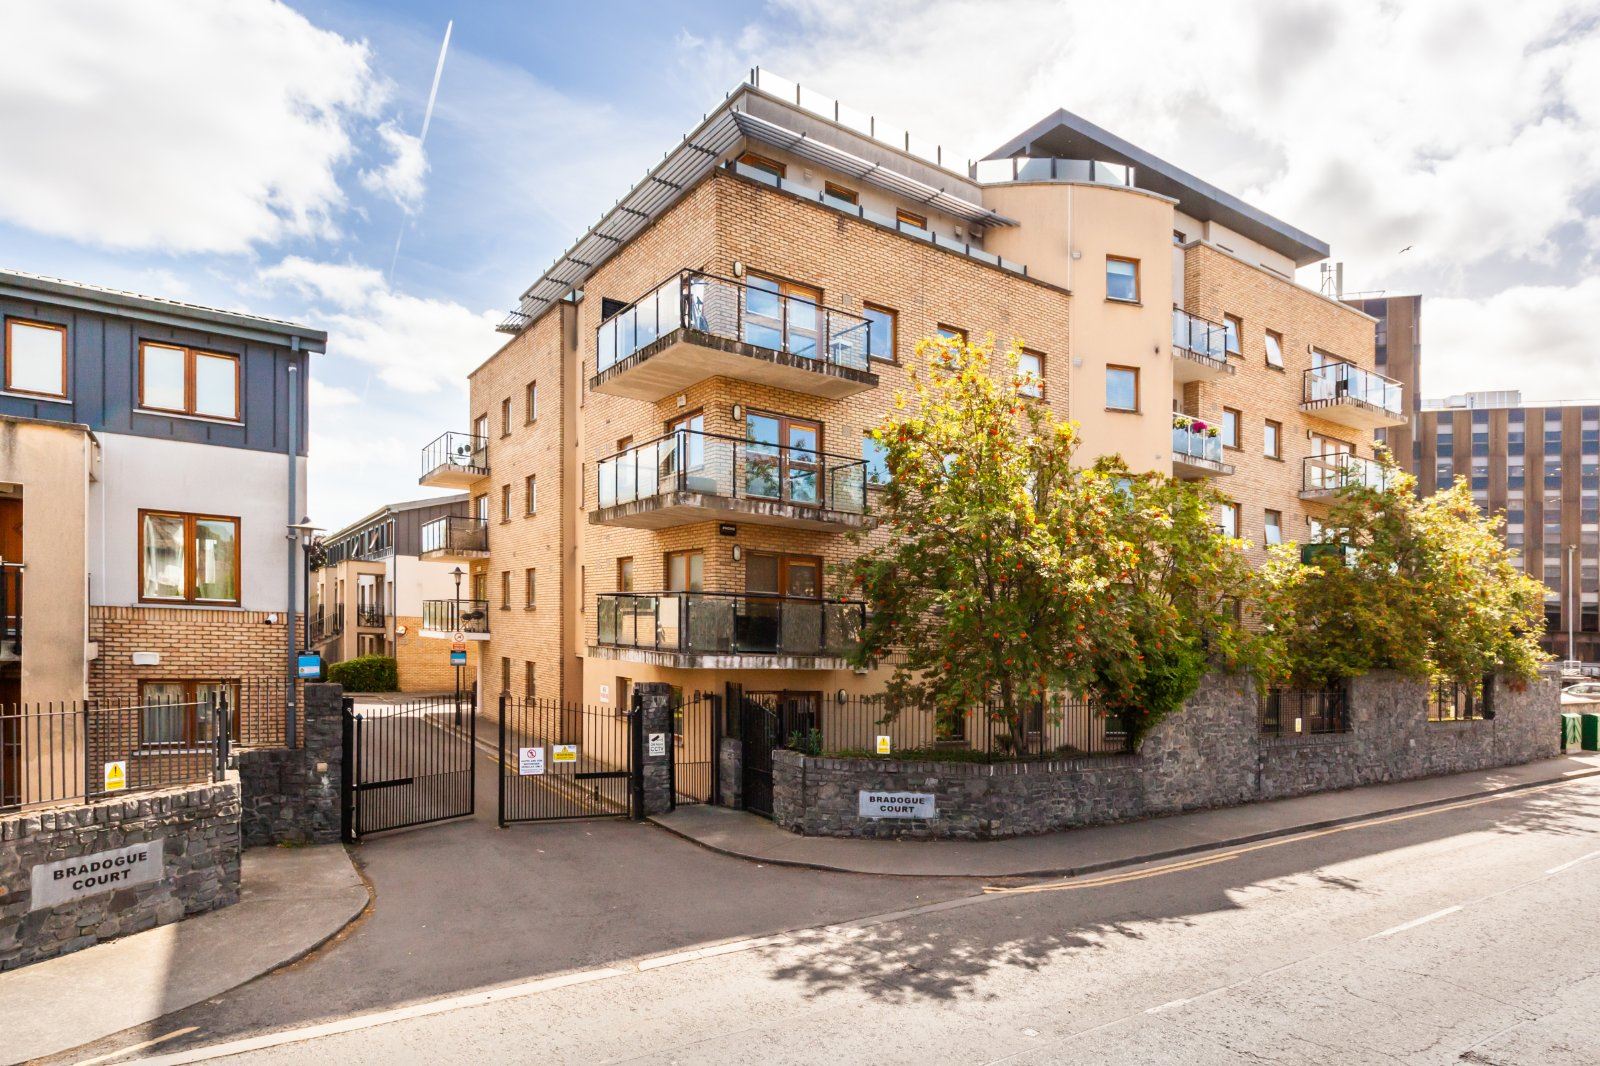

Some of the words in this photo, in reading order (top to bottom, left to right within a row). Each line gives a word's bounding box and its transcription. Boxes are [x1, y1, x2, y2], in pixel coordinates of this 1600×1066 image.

[869, 796, 925, 805] BRADOGUE
[880, 805, 915, 813] COURT
[53, 851, 147, 881] BRADOGUE
[72, 869, 131, 891] COURT
